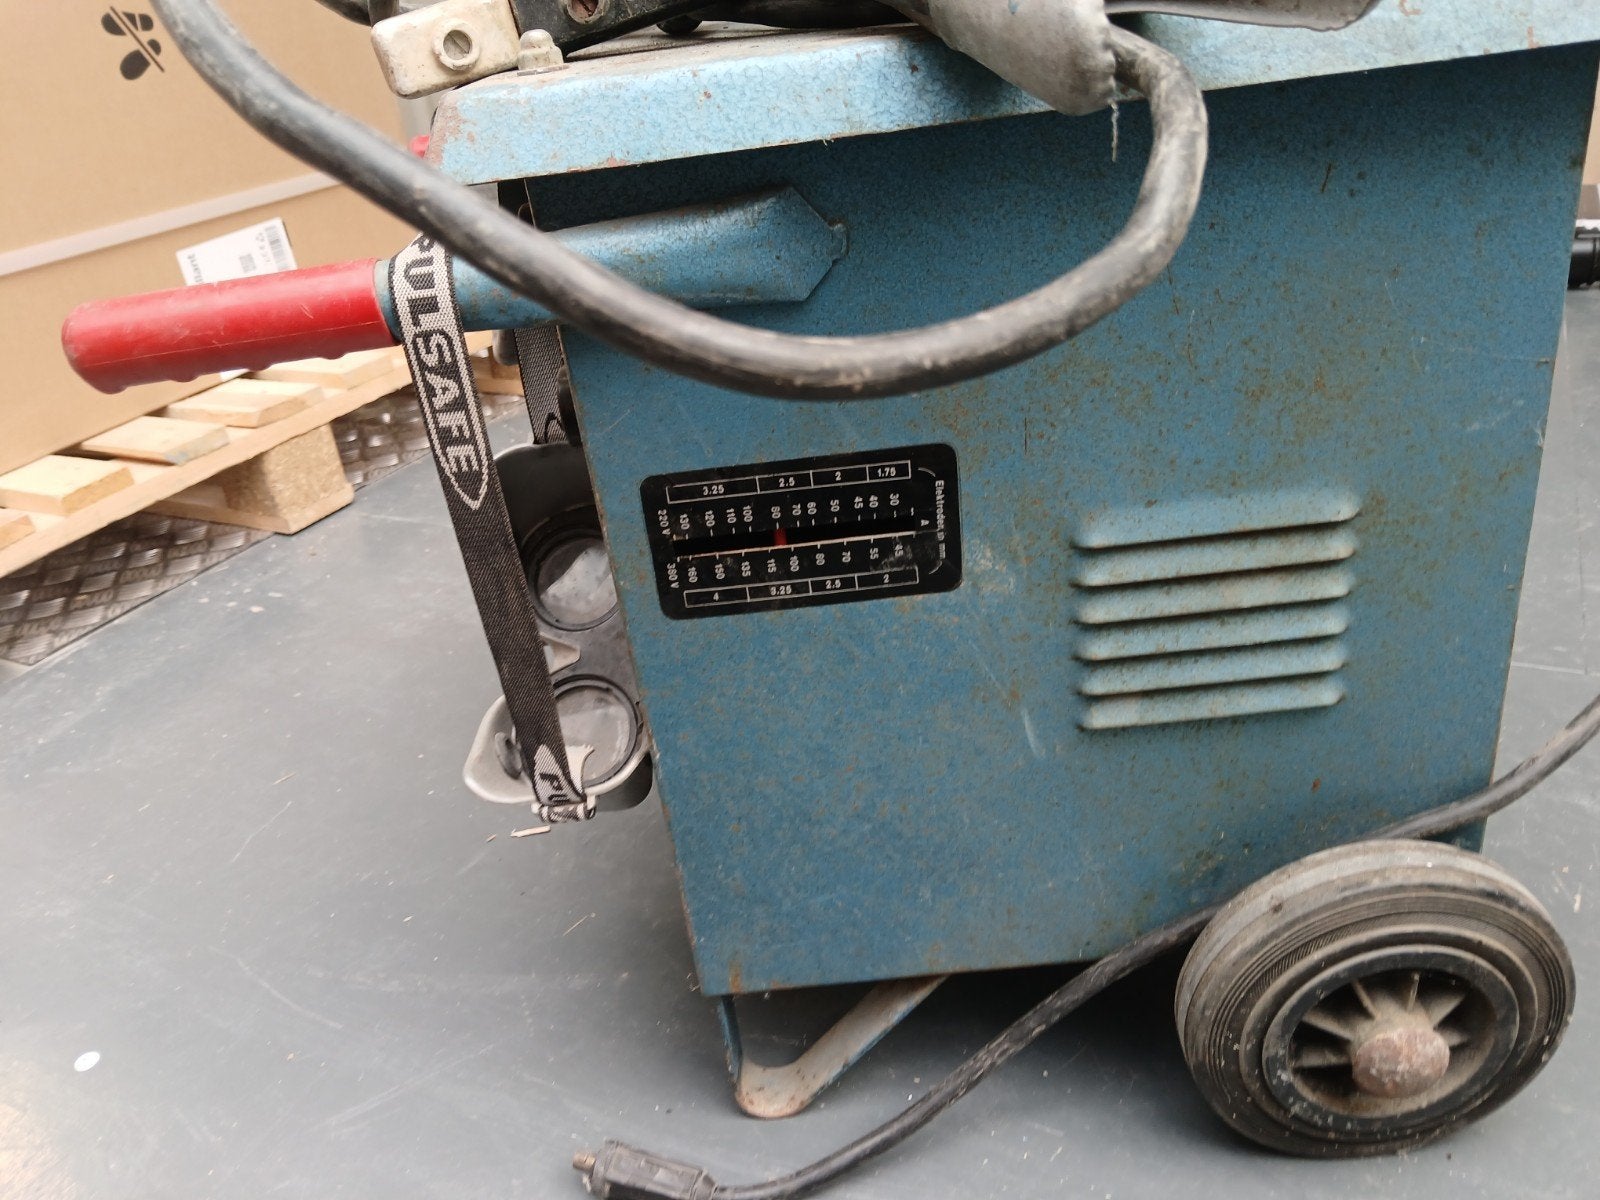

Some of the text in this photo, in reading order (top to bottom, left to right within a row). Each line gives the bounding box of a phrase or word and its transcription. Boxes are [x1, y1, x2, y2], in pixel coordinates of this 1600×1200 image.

[703, 467, 896, 495] 3.25 2.5 2 1.75
[830, 500, 840, 512] 50
[854, 496, 863, 509] 45
[869, 495, 878, 508] 40
[890, 493, 899, 506] 30
[935, 480, 946, 530] Elektroden
[726, 508, 736, 523] 110
[743, 505, 753, 522] 100
[792, 504, 801, 515] 70
[807, 502, 817, 515] 60
[658, 509, 669, 527] 220
[680, 514, 690, 530] 130
[705, 510, 715, 527] 120
[842, 551, 851, 563] 70
[870, 547, 879, 560] 55
[895, 544, 903, 557] 45
[939, 543, 946, 559] mm
[767, 558, 777, 573] 115
[790, 555, 799, 572] 100
[816, 553, 825, 565] 80
[667, 563, 678, 581] 380
[688, 567, 698, 583] 160
[715, 563, 725, 580] 150
[742, 561, 751, 577] 135
[713, 574, 889, 601] 4 3.25 2.5 2
